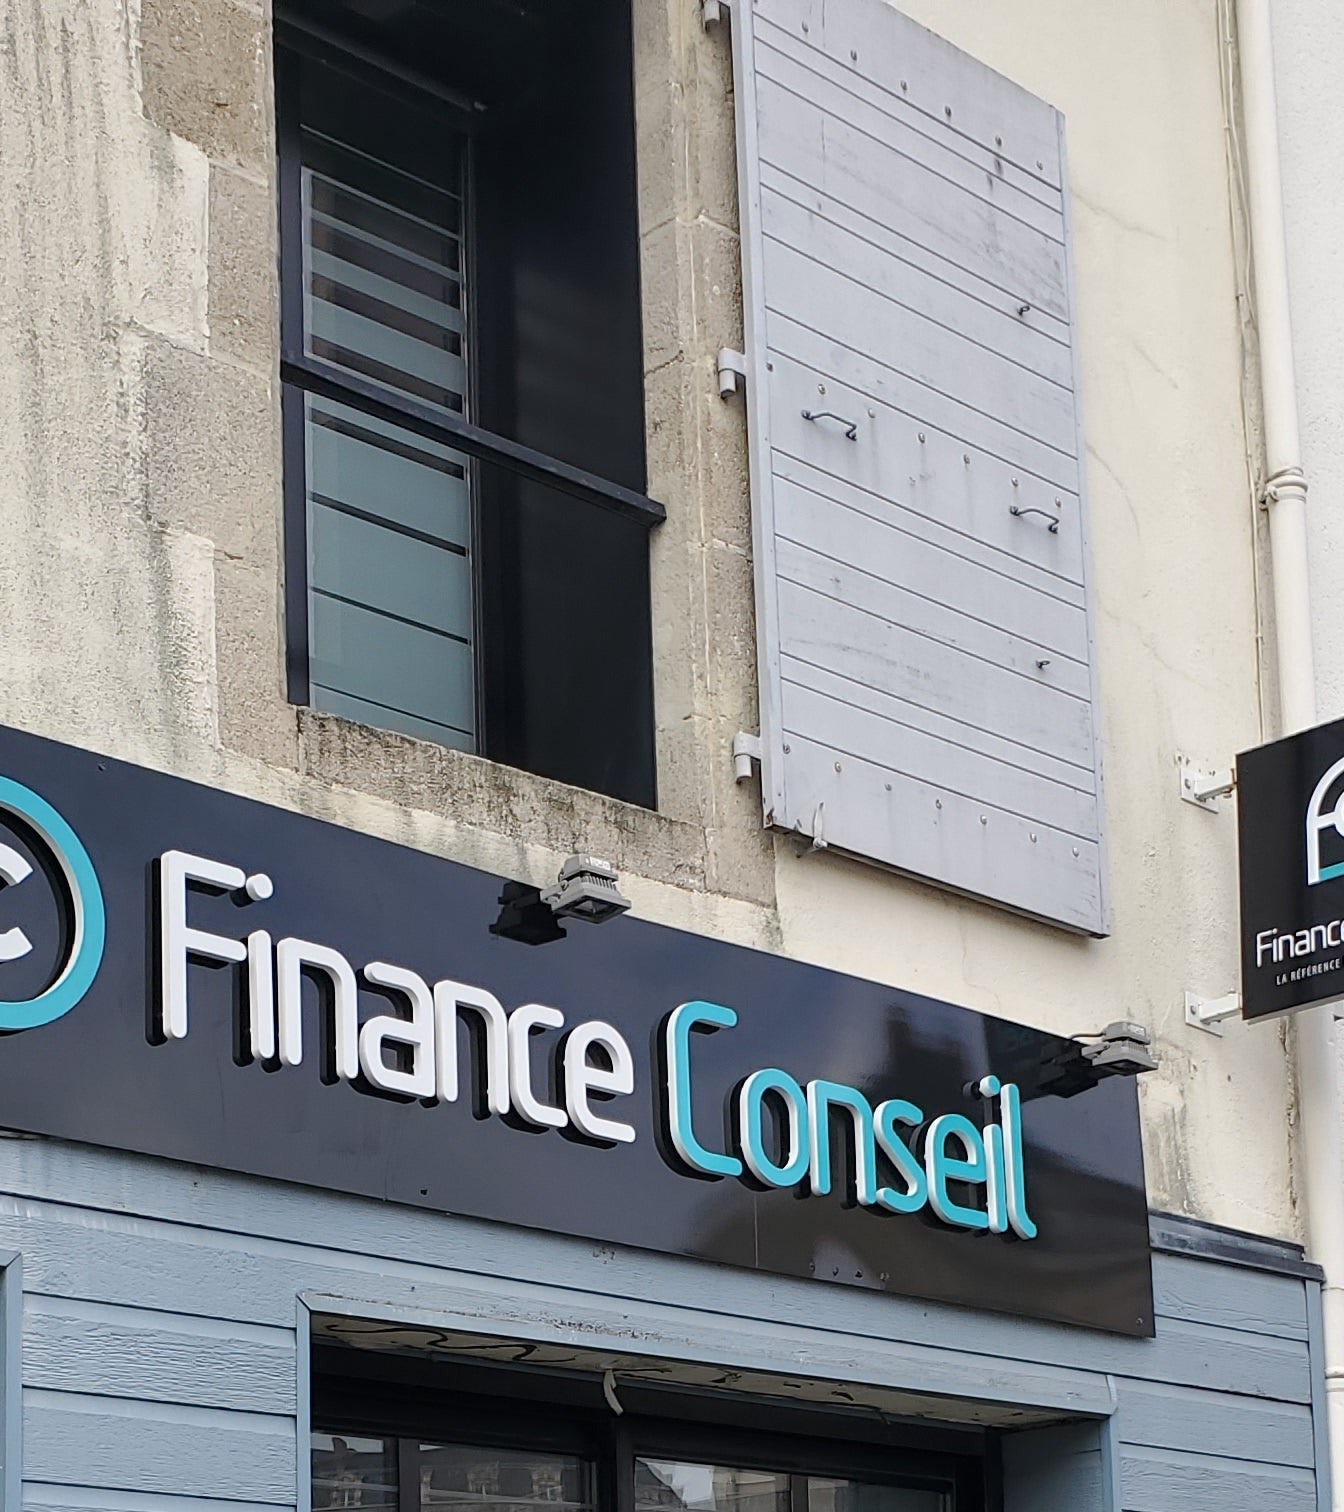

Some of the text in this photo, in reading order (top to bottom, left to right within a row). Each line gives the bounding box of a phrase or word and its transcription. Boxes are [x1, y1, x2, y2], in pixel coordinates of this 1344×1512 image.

[159, 849, 1038, 1240] Finance Conseil
[1275, 973, 1288, 986] LA
[1290, 958, 1341, 981] RÉFÉRENCE
